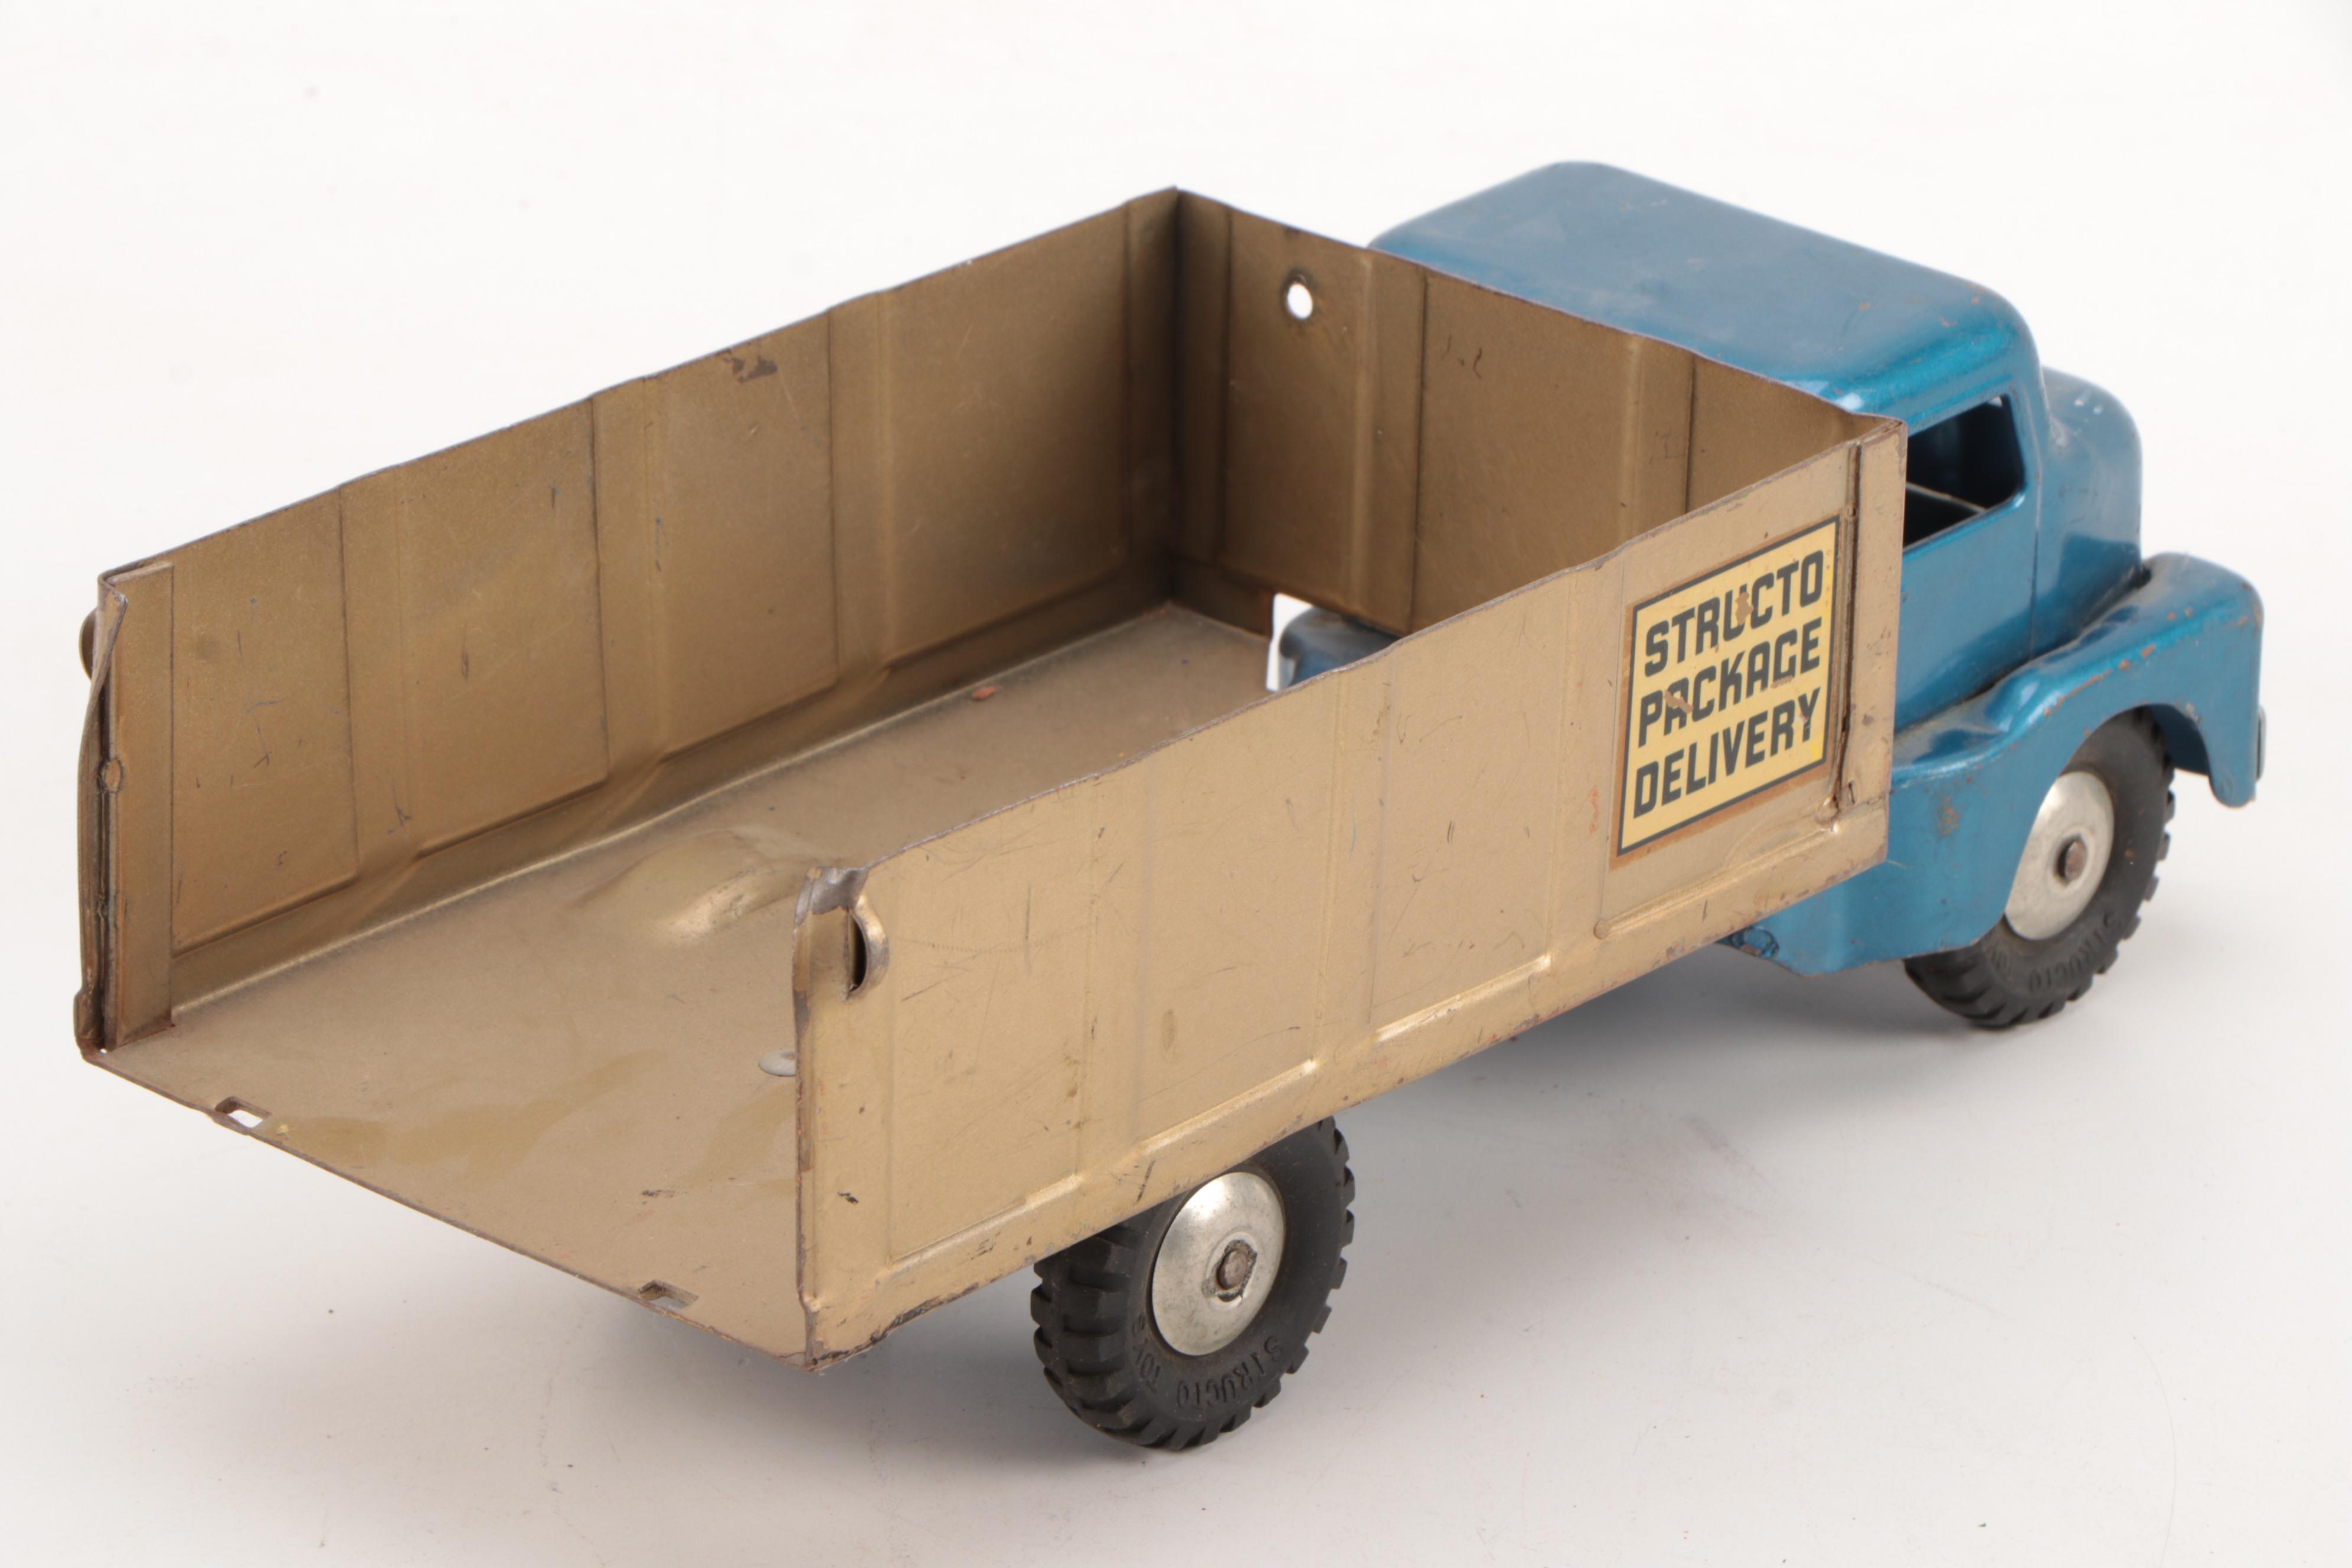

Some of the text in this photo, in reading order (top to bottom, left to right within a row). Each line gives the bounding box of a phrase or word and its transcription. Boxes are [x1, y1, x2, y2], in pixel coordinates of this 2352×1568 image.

[1644, 551, 1824, 677] STRUCTO
[1638, 617, 1822, 747] PACKAGE
[1634, 687, 1821, 818] DELIVERY
[1176, 1335, 1283, 1409] STRUCTO
